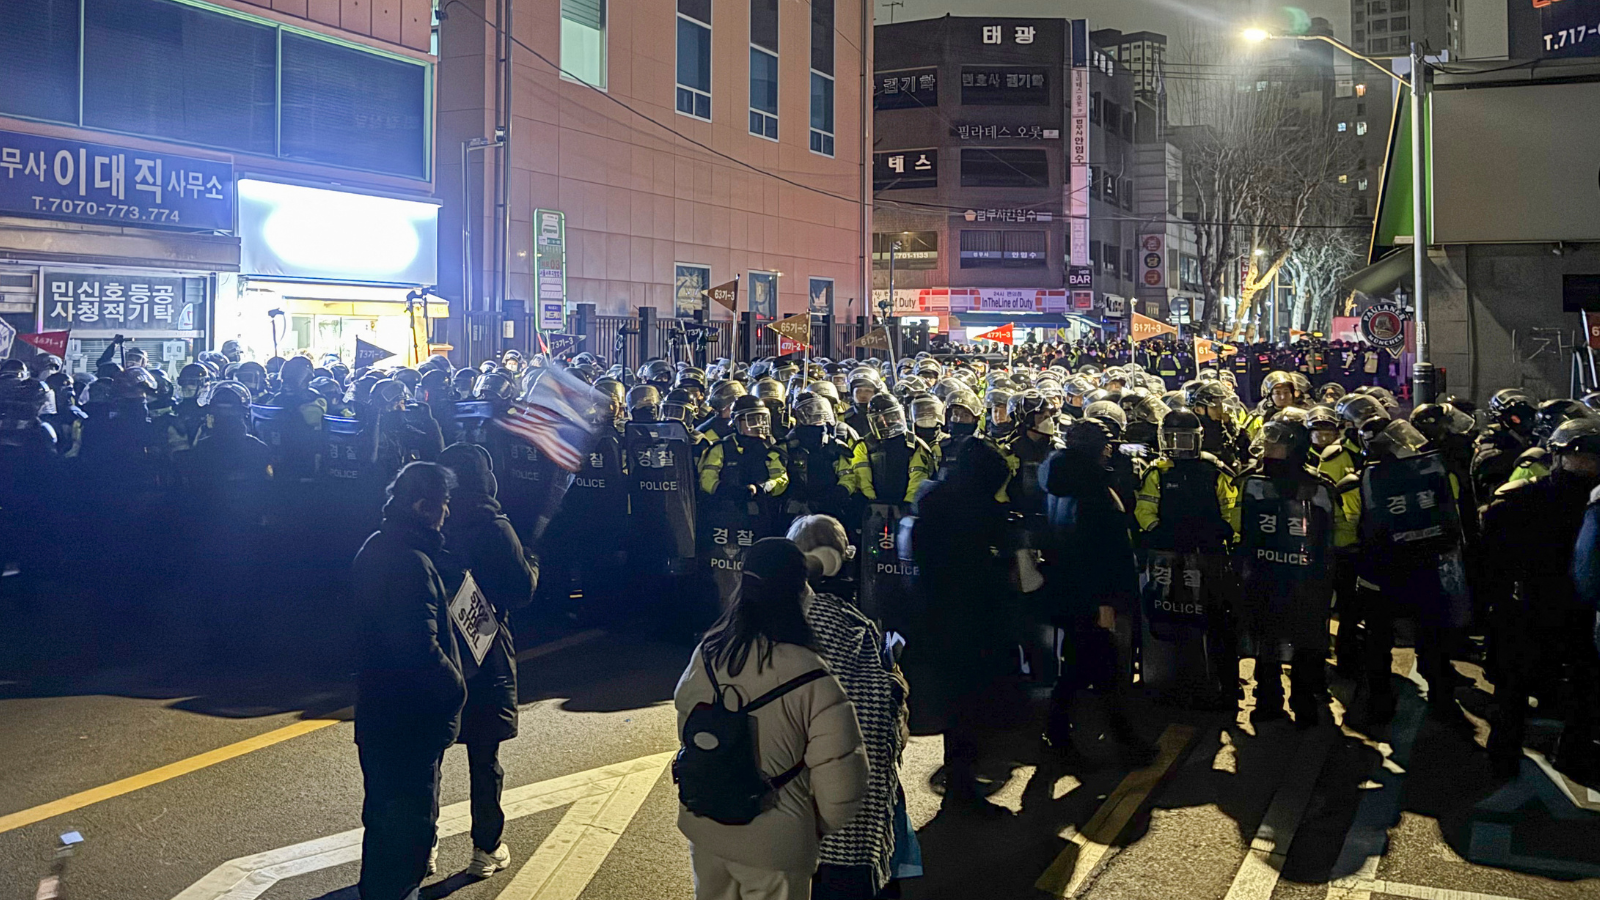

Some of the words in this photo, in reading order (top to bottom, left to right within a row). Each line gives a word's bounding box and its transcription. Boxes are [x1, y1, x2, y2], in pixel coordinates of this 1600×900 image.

[982, 25, 1036, 45] 태광
[1543, 22, 1600, 51] T.717-
[884, 74, 936, 95] 권기학
[962, 73, 1000, 88] 변호사
[958, 125, 1011, 140] 필라테스
[1016, 125, 1043, 141] 오롯
[888, 154, 932, 173] 테스
[53, 147, 163, 205] 이대직
[167, 169, 224, 200] 사무소
[31, 195, 181, 223] T.7070-773.774
[1069, 275, 1091, 284] BAR
[899, 297, 917, 309] Duty
[1012, 297, 1019, 308] of
[1020, 297, 1034, 310] Duty
[638, 450, 675, 467] 경찰
[640, 480, 678, 491] POLICE
[1258, 513, 1309, 537] 경찰
[712, 527, 755, 547] 경찰
[710, 557, 742, 571] POLIC
[1257, 548, 1309, 566] POLICE
[876, 562, 920, 576] POLICE
[1154, 599, 1204, 615] POLICE
[458, 607, 480, 650] STEAL
